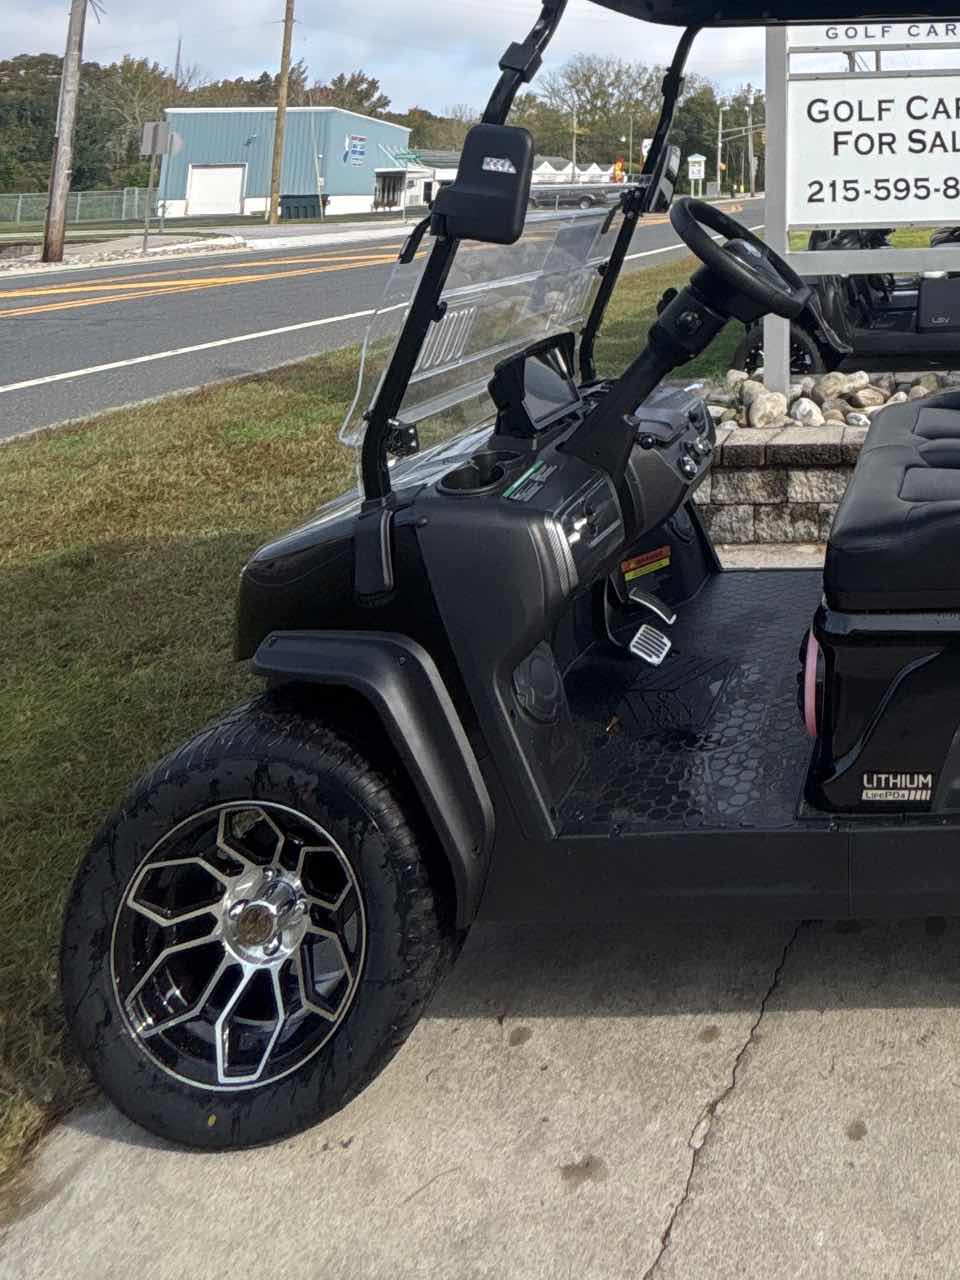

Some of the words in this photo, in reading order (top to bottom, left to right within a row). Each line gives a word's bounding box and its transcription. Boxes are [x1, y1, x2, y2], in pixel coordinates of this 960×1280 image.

[825, 25, 893, 40] GOLF
[806, 98, 895, 123] GOLF
[832, 130, 897, 156] FOR
[863, 773, 932, 789] LITHIUM
